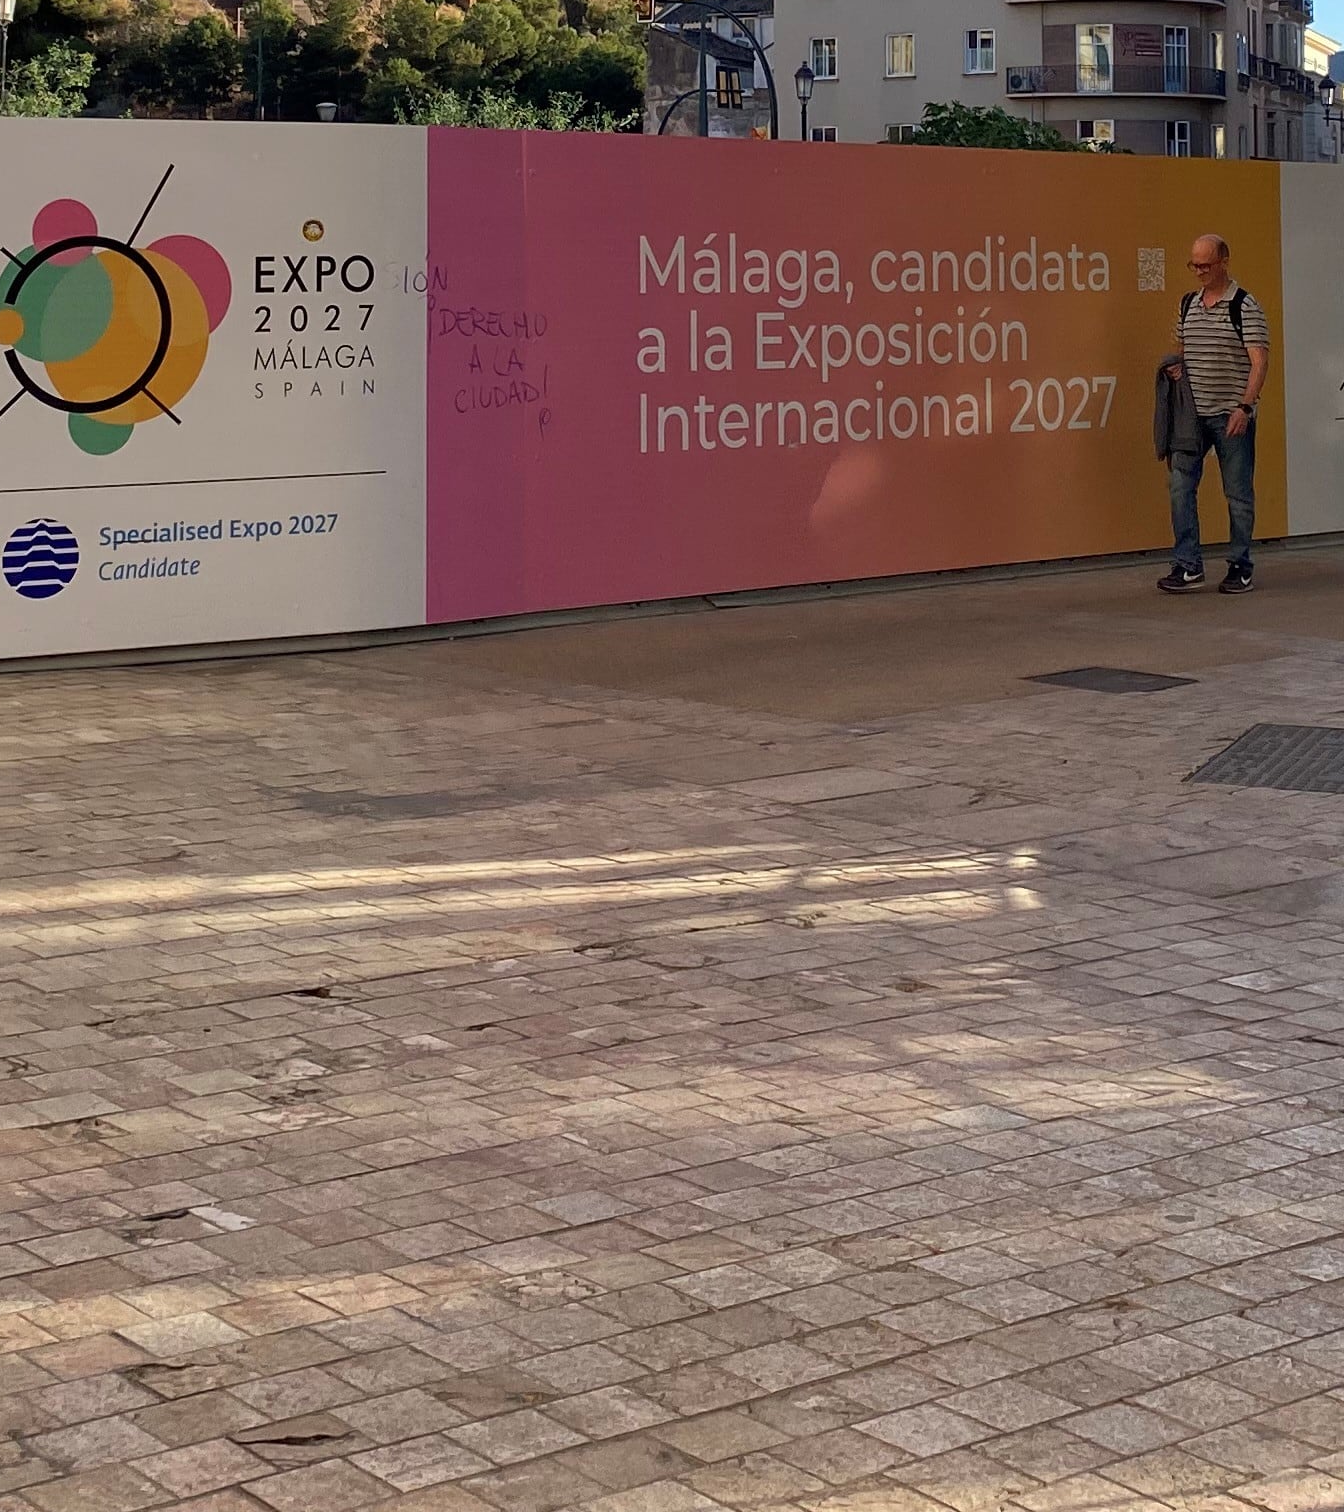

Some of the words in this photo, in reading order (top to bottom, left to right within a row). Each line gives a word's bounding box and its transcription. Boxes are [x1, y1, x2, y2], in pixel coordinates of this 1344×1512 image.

[254, 254, 375, 293] EXPO
[639, 232, 854, 309] Málaga,
[870, 235, 1111, 293] candidata
[254, 304, 375, 333] 2027
[254, 338, 375, 371] MÁLAGA
[637, 326, 666, 373] a
[690, 309, 733, 372] la
[756, 305, 1028, 383] Exposición
[254, 378, 375, 400] SPAIN
[639, 377, 993, 454] Internacional
[1008, 375, 1117, 434] 2027
[99, 518, 223, 551] Specialised
[229, 518, 283, 542] Expo
[288, 513, 339, 535] 2027
[98, 556, 201, 581] Candidate
